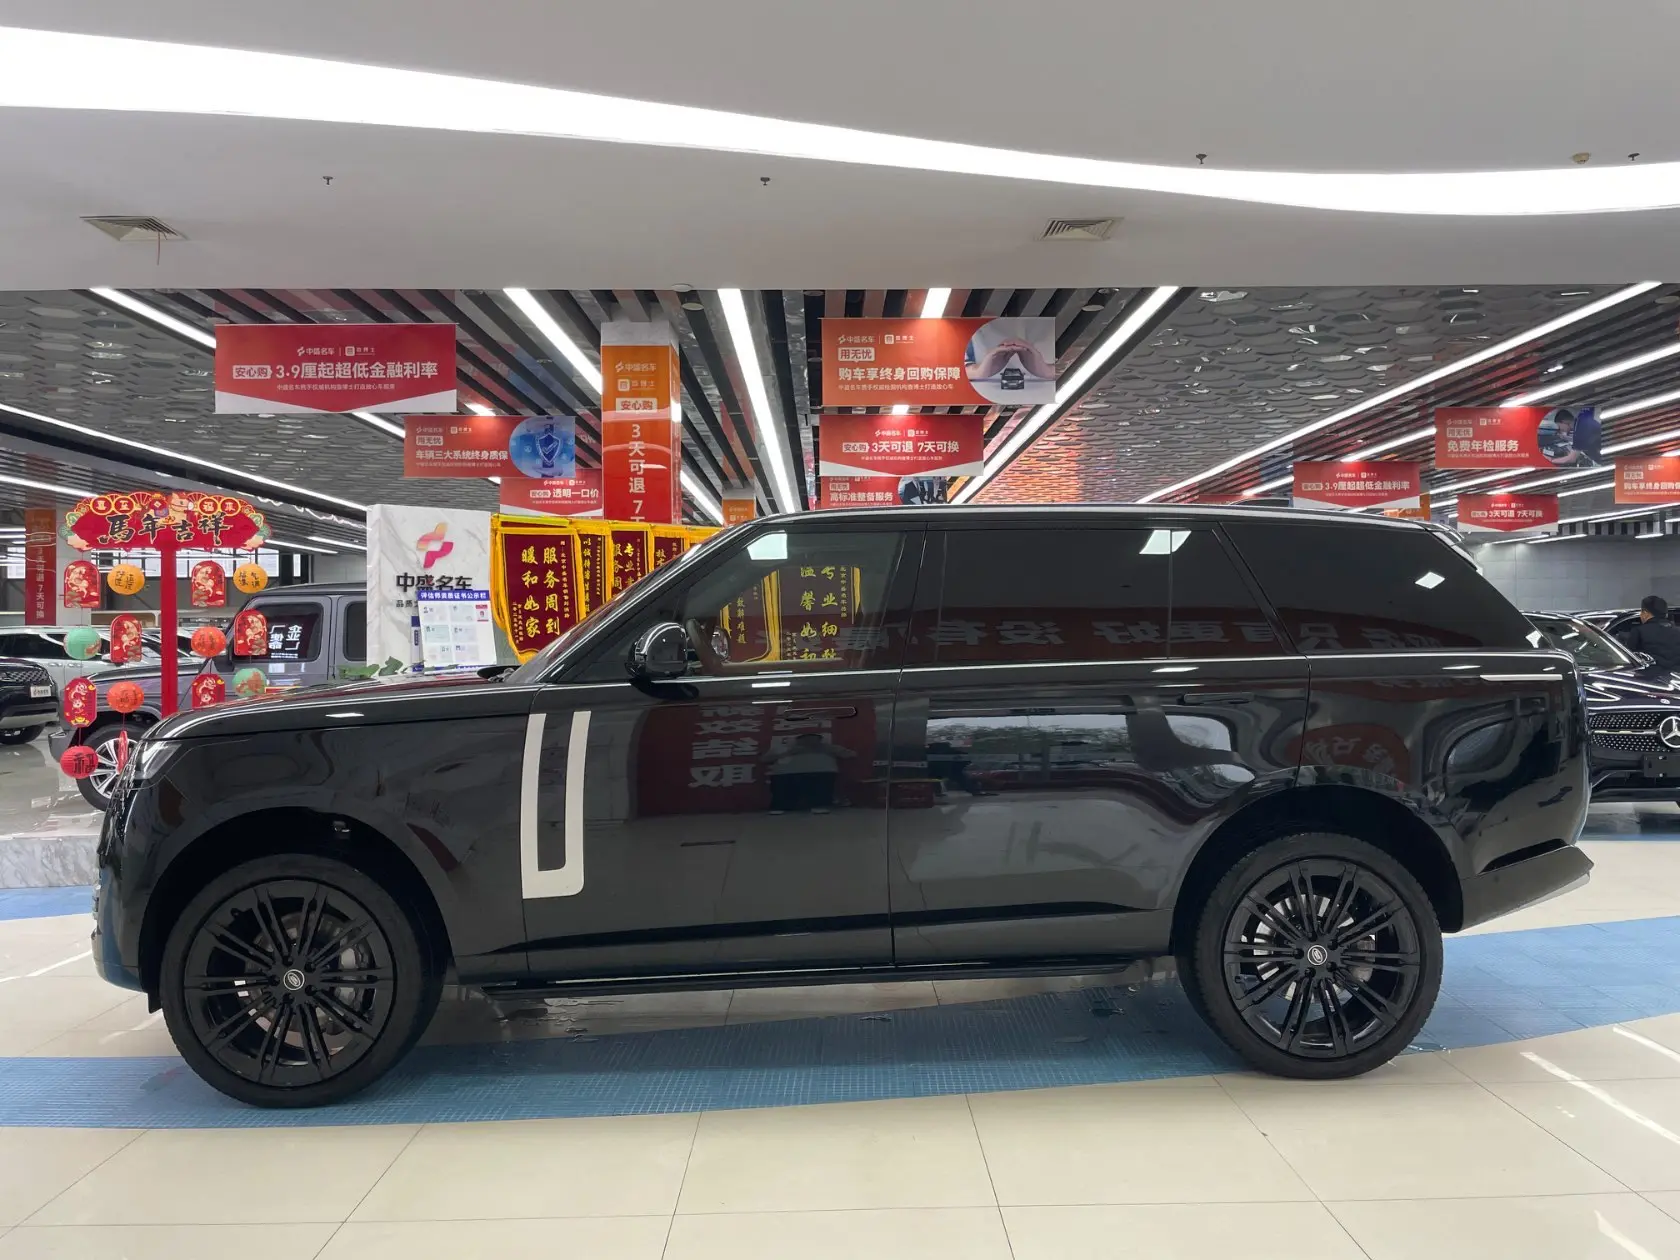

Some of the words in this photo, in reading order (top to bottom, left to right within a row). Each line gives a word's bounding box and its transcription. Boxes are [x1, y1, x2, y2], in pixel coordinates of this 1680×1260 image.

[839, 349, 873, 360] 用无忧
[235, 367, 269, 378] 安心购
[275, 362, 438, 379] 3.9厘起超低金融利率
[838, 367, 961, 381] 购车享终身回购保障
[621, 400, 653, 410] 安心购
[871, 441, 914, 453] 3天可退
[917, 441, 960, 453] 7天可换
[1447, 439, 1519, 452] 免费年检服务
[415, 450, 508, 460] 车辆三大系统终身质保
[629, 424, 646, 493] 3天可退
[553, 488, 599, 498] 透明一口价
[98, 511, 233, 546] 馬年吉祥
[396, 572, 473, 592] 中盛名车
[543, 547, 561, 636] 服务周到
